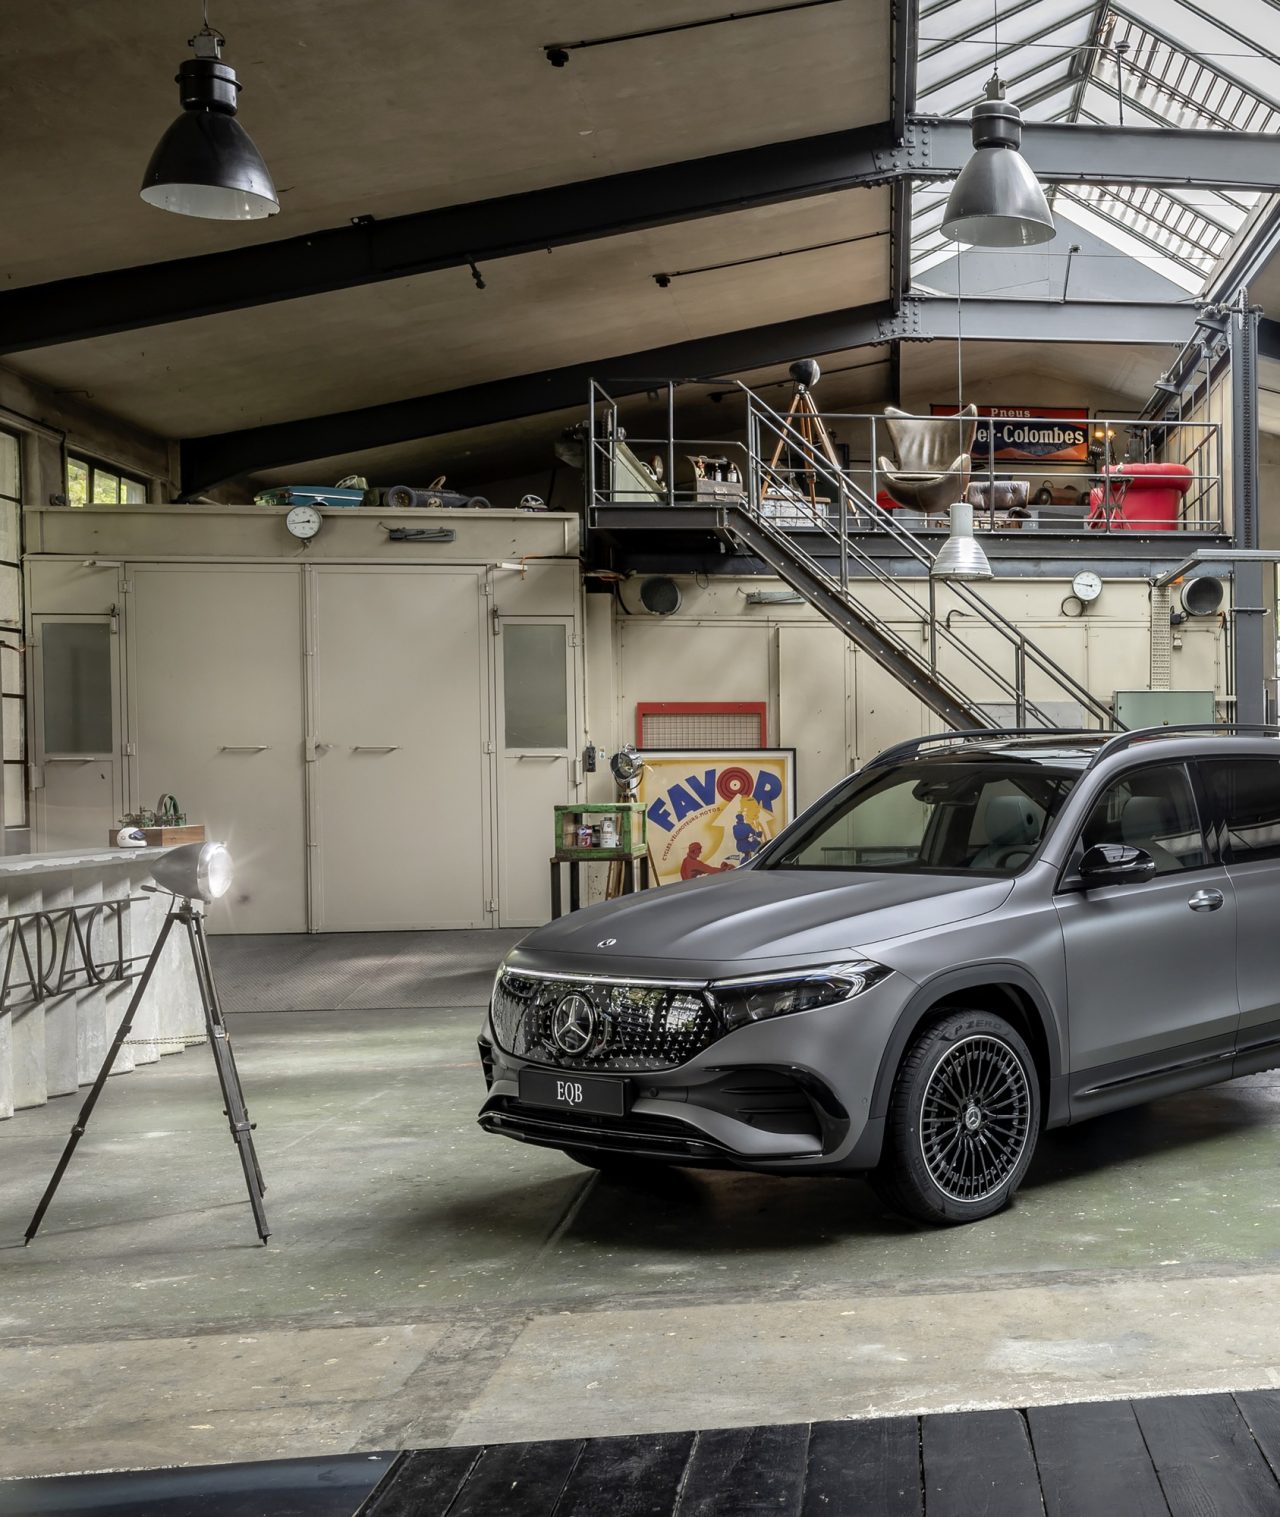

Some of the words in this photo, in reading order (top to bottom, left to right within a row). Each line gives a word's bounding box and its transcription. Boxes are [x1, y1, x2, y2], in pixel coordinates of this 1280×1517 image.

[990, 407, 1031, 418] Pneus
[647, 766, 782, 832] FAVOR
[965, 1019, 1002, 1030] ZERO
[556, 1081, 583, 1106] EQB
